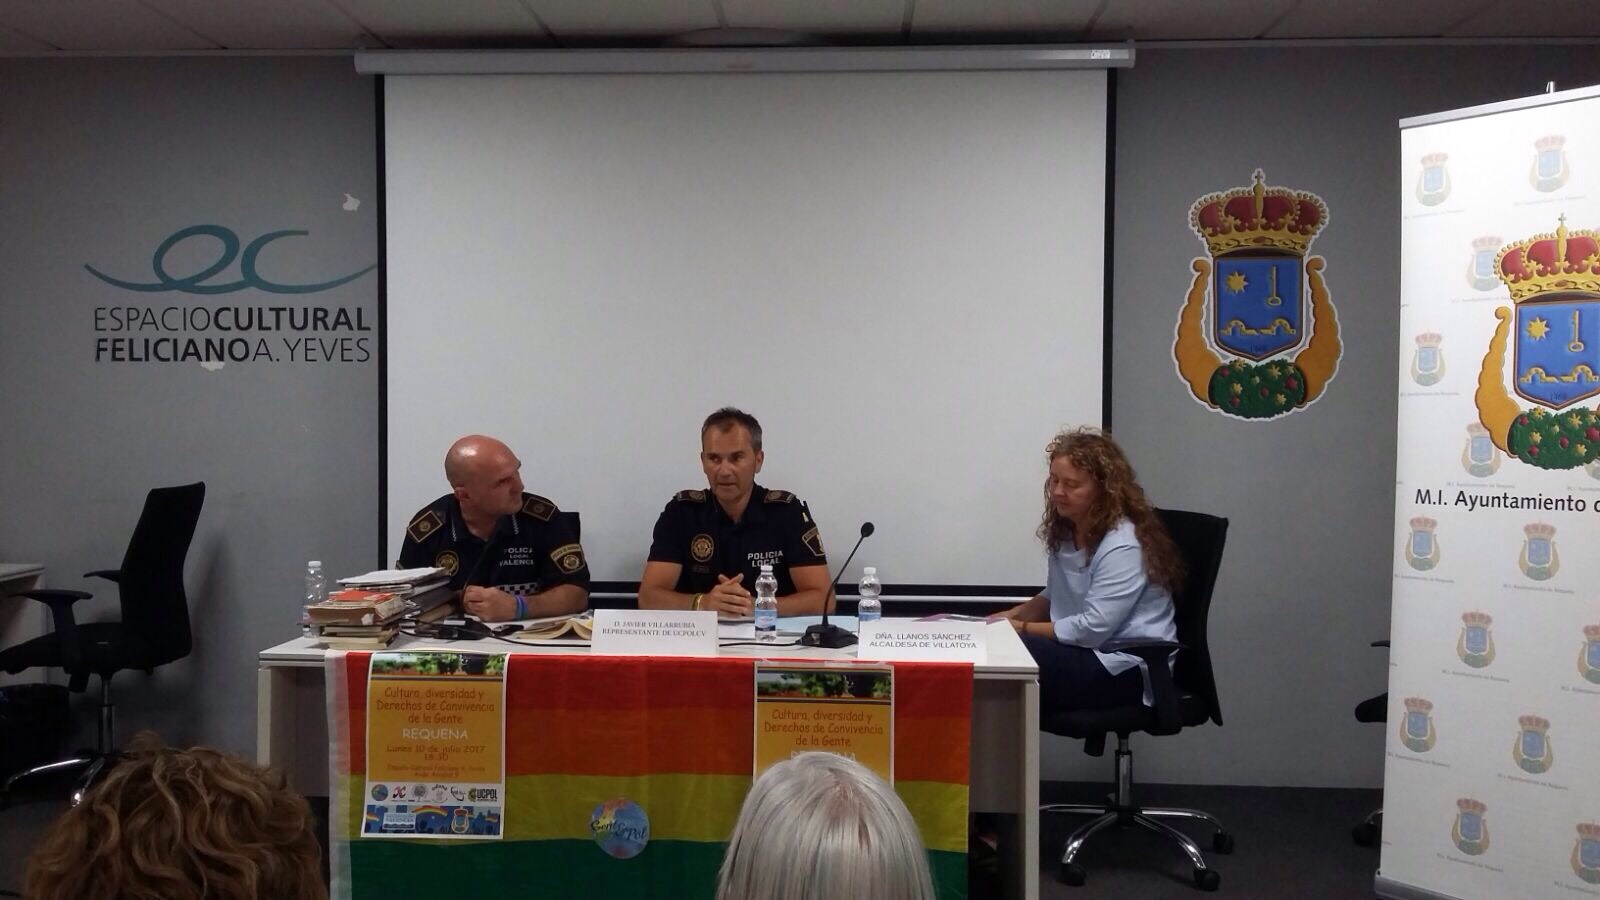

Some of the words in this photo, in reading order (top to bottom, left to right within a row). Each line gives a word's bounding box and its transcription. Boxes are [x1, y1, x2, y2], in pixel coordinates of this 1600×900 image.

[1415, 489, 1447, 505] M.I.
[1454, 490, 1586, 512] Ayuntamiento
[747, 550, 784, 560] POLICIA
[752, 558, 781, 568] LOCAL
[602, 628, 660, 636] REPRESENTANTE
[425, 687, 475, 698] diversidad
[478, 691, 484, 700] y
[376, 700, 422, 711] Derechos
[425, 701, 437, 711] de
[440, 700, 495, 712] Convivencia
[408, 713, 420, 723] de
[423, 713, 432, 723] la
[435, 712, 463, 724] Gente
[813, 710, 864, 722] diversidad
[867, 713, 873, 724] y
[402, 728, 469, 741] REQUENA
[764, 722, 810, 733] Derechos
[813, 722, 825, 733] de
[828, 723, 884, 735] Convivencia
[795, 734, 807, 745] de
[811, 735, 819, 746] la
[822, 736, 851, 747] Gente
